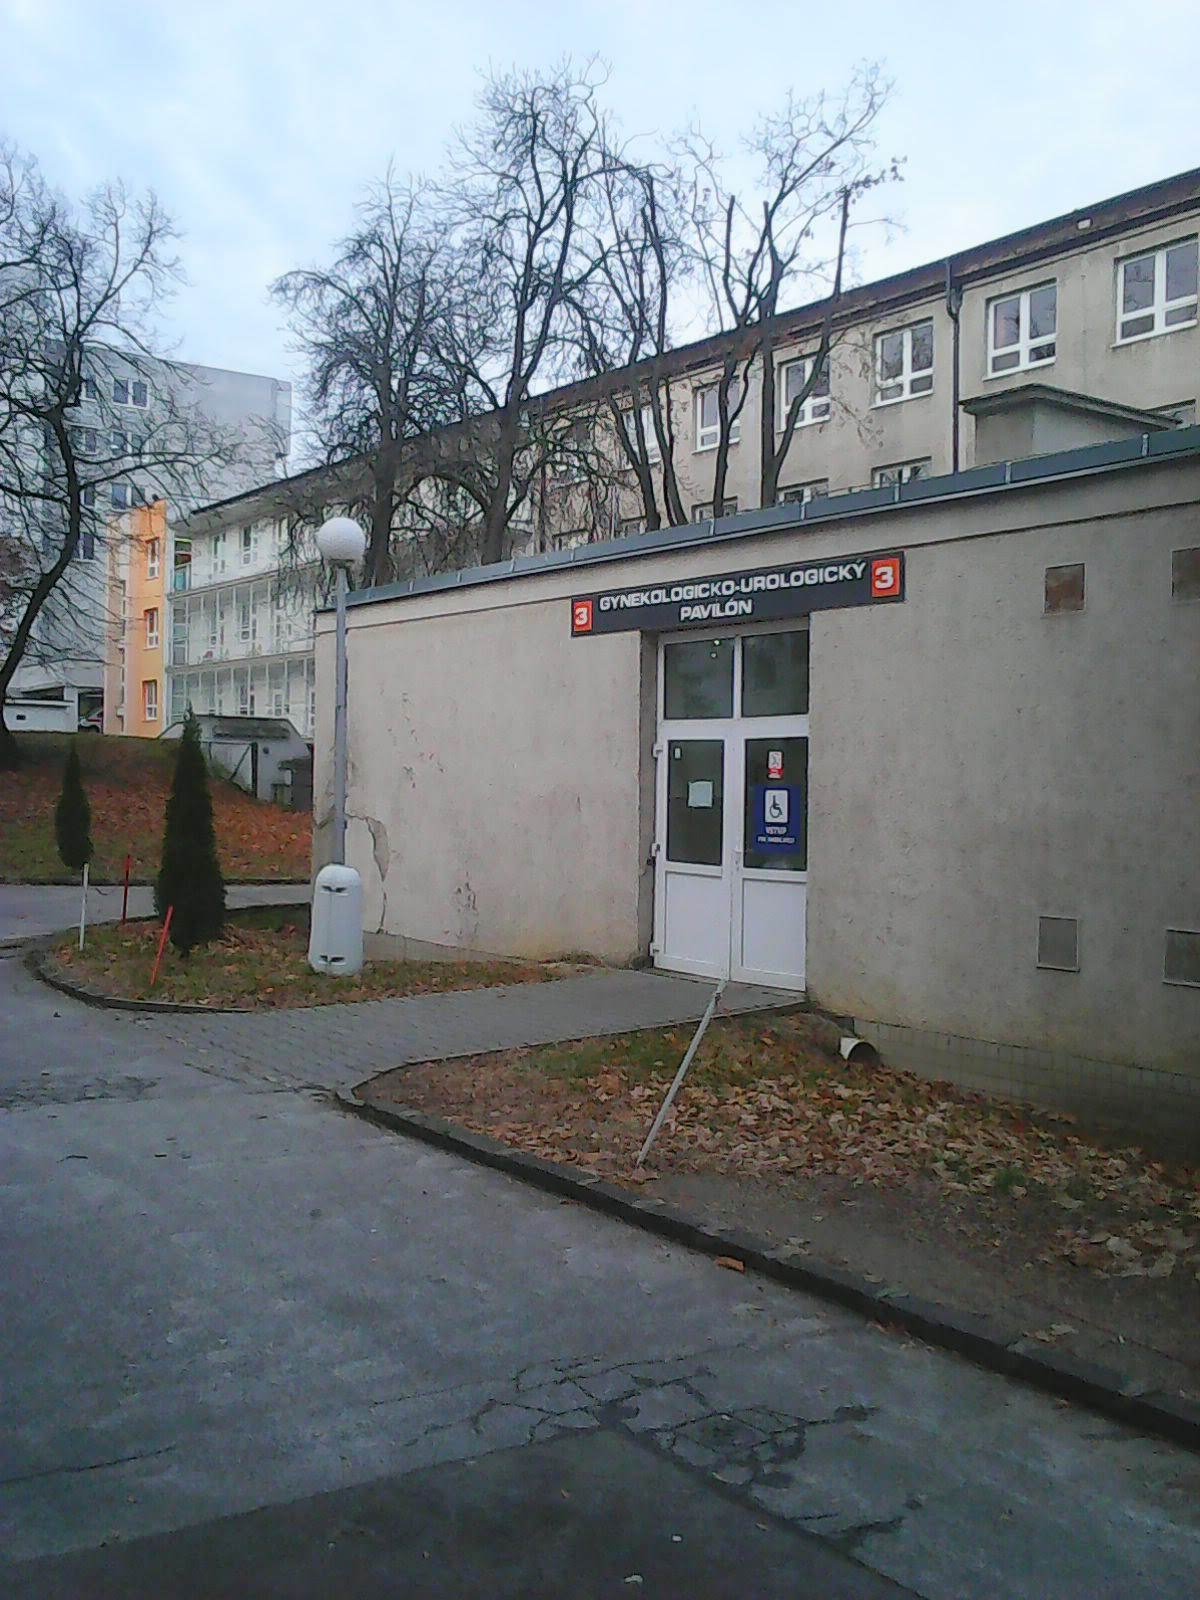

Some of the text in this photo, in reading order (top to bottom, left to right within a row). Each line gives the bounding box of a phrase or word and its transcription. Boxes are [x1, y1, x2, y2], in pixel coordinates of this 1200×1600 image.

[599, 562, 867, 611] GYNEKOLOGICKO-UROLOGICKÝ
[874, 566, 895, 590] 3
[575, 608, 588, 625] 3
[680, 598, 753, 622] PAVILÓN
